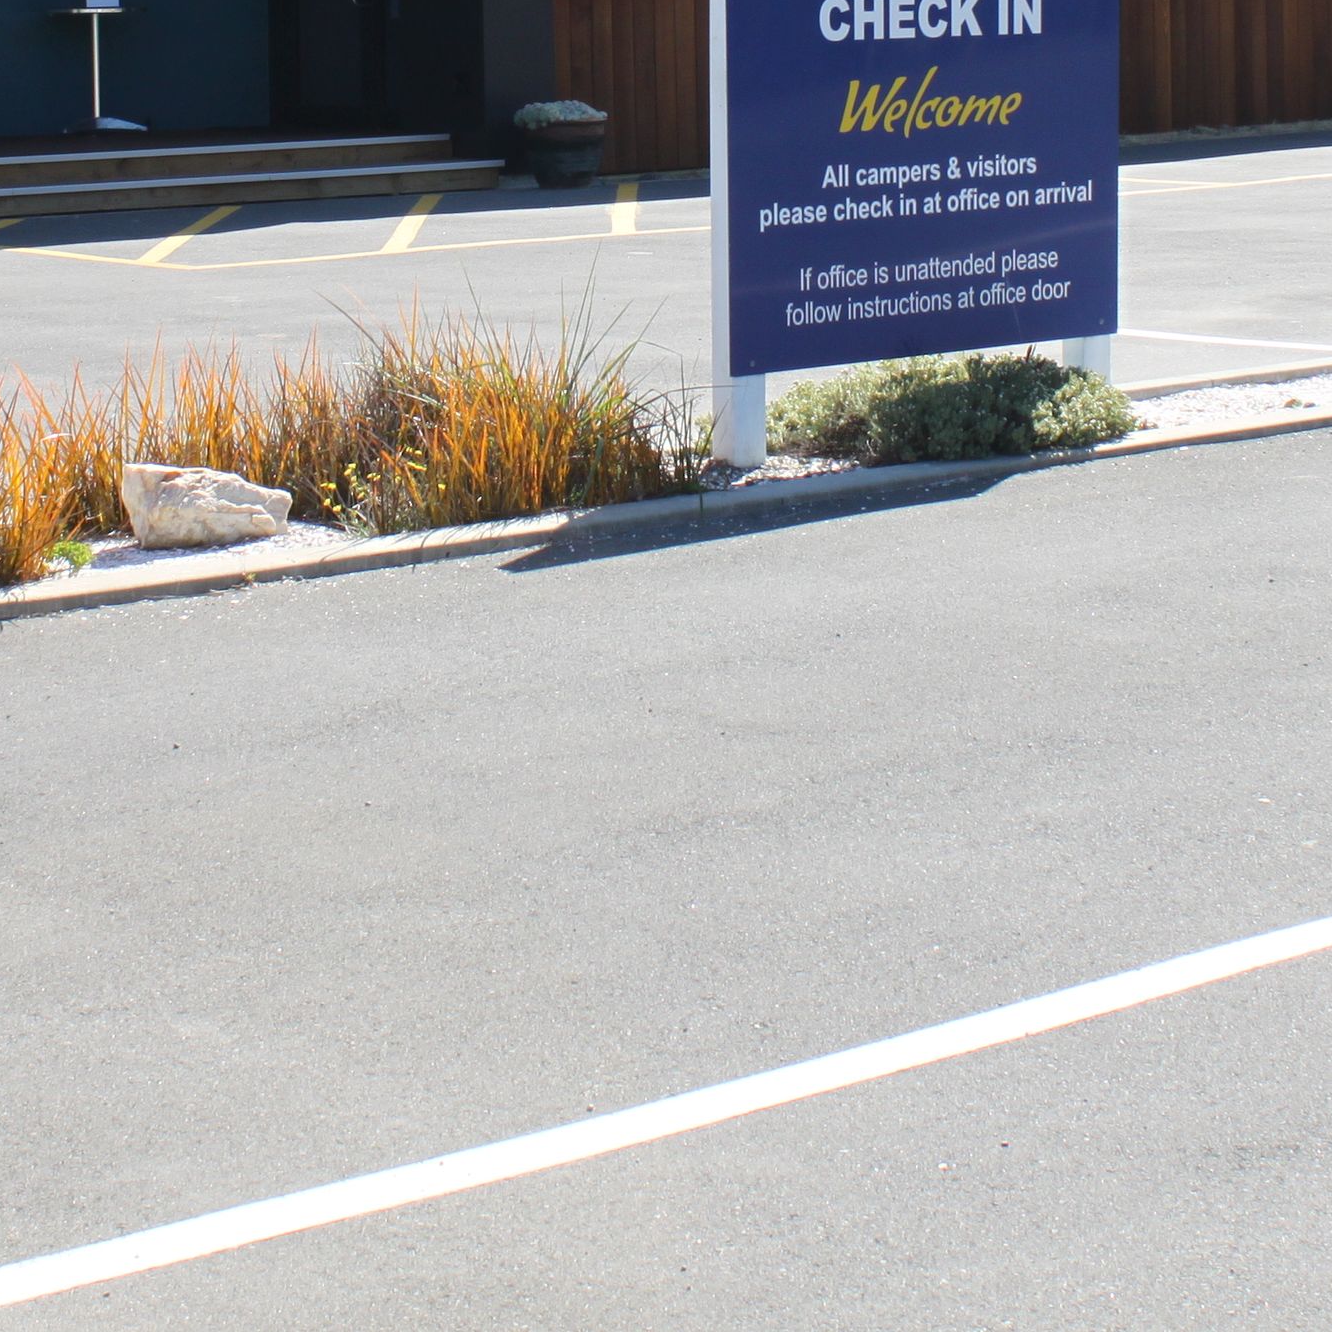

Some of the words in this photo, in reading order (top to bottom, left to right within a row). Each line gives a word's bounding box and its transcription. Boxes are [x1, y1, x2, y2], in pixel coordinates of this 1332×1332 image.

[838, 66, 1022, 138] Welcome
[822, 164, 849, 189] All
[856, 158, 941, 189] campers
[947, 156, 961, 180] &
[967, 154, 1037, 178] visitors
[759, 202, 827, 232] please
[833, 195, 893, 222] check
[900, 192, 917, 215] in
[923, 192, 941, 213] at
[947, 188, 1000, 211] office
[1006, 190, 1029, 207] on
[1035, 180, 1092, 205] arrival
[800, 267, 813, 290] If
[817, 262, 868, 289] office
[874, 259, 888, 284] is
[895, 251, 996, 282] unattended
[1001, 249, 1059, 278] please
[786, 301, 841, 326] follow
[847, 292, 952, 320] instructions
[958, 290, 975, 309] at
[980, 282, 1026, 306] office
[1031, 279, 1071, 301] door
